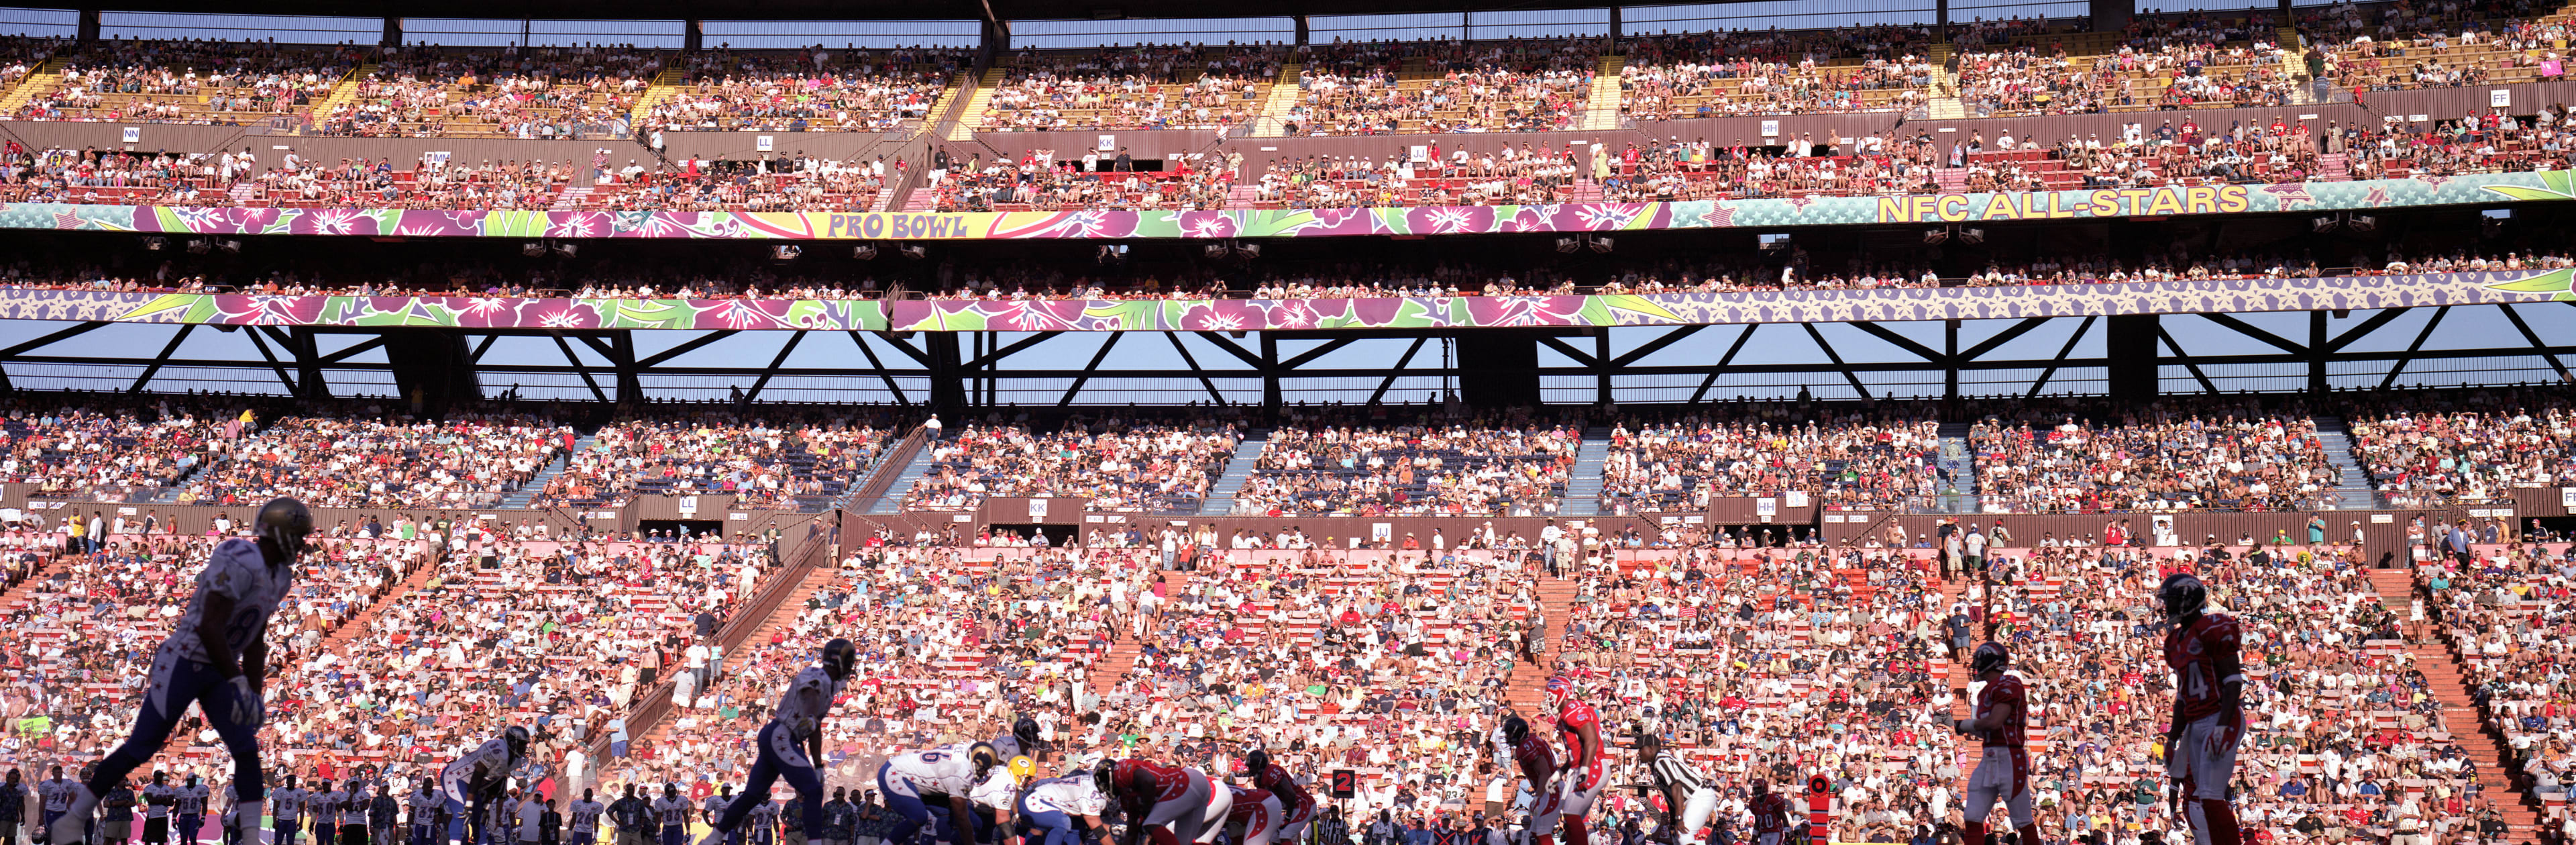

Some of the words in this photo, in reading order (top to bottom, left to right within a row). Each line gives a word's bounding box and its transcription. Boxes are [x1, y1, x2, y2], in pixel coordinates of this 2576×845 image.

[2493, 95, 2506, 103] FF
[1413, 150, 1424, 158] JJ
[1878, 195, 1970, 223] NFC
[1981, 185, 2249, 221] ALL-STARS
[827, 213, 884, 239] PRO
[890, 213, 968, 239] BOWL
[681, 499, 694, 507] LL
[1030, 503, 1045, 512] KK
[1758, 503, 1774, 511] HH
[1375, 528, 1388, 537] JJ
[16, 615, 25, 623] 21
[1061, 715, 1069, 725] 85
[1335, 773, 1351, 791] 2
[53, 793, 67, 804] 78
[285, 798, 292, 810] 5
[578, 812, 592, 824] 26
